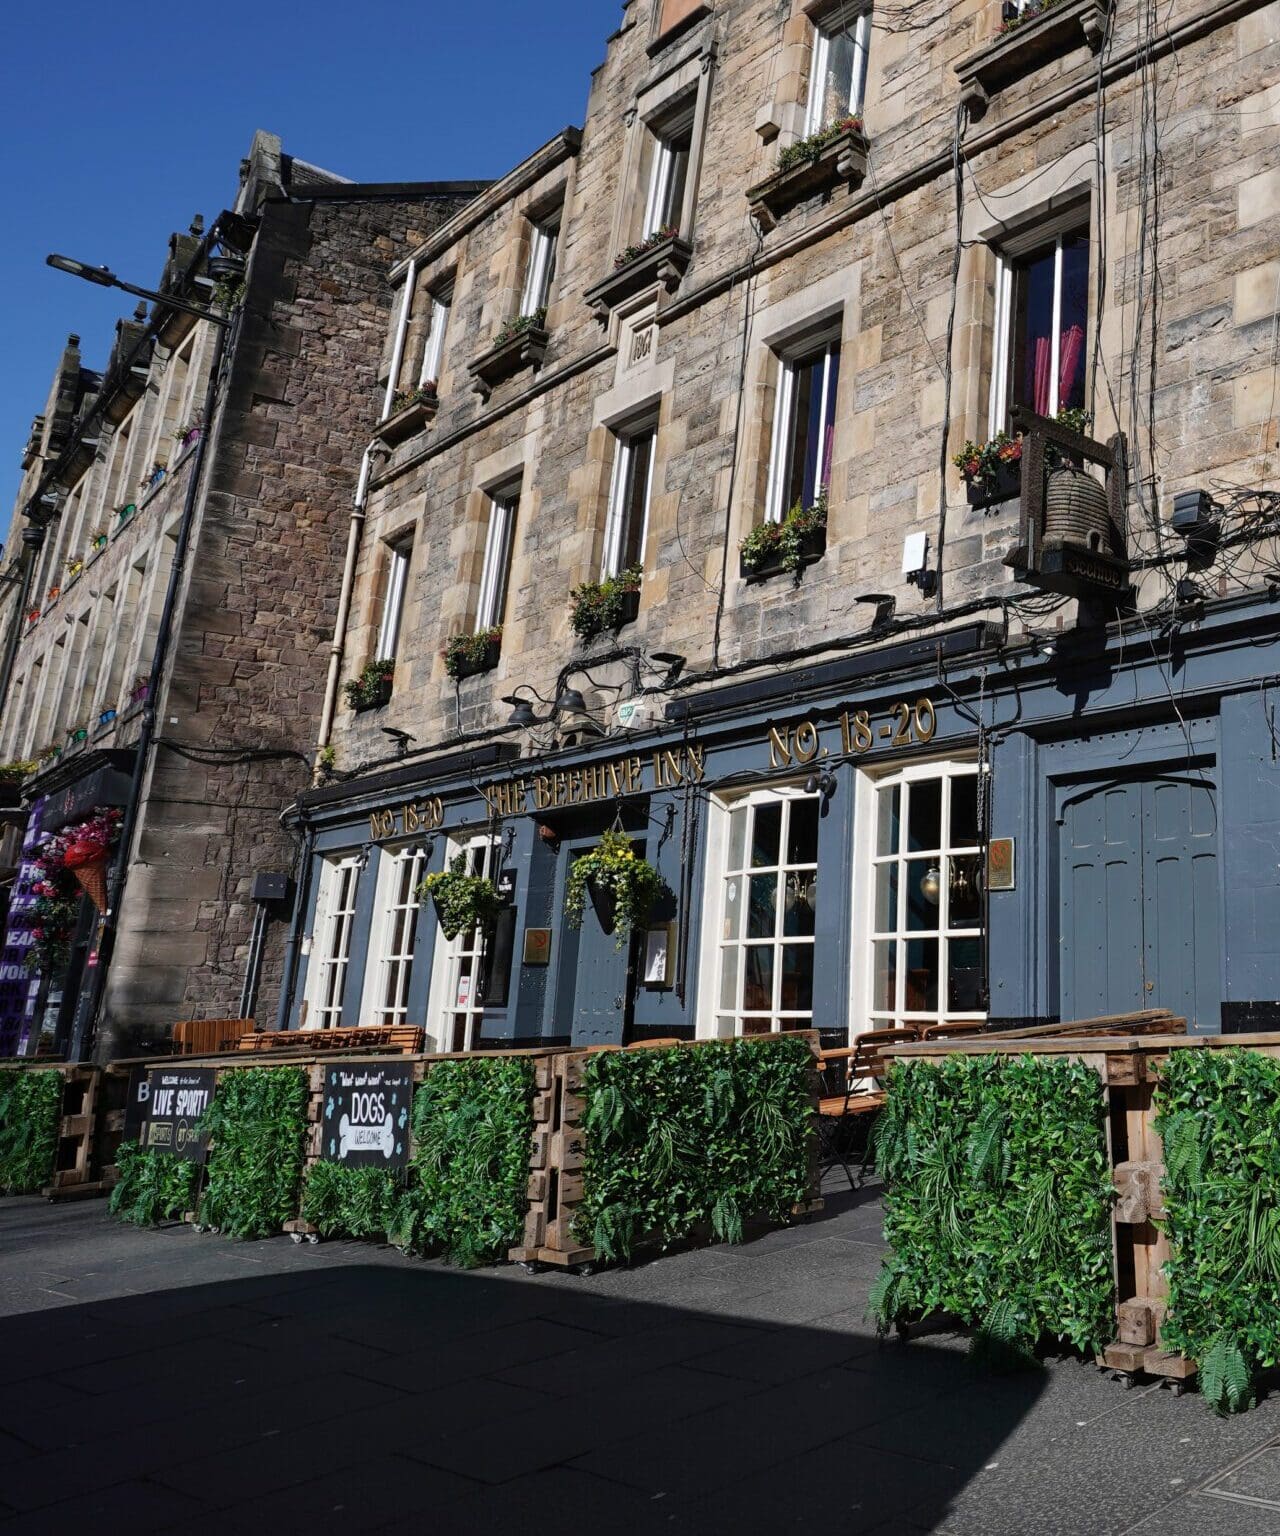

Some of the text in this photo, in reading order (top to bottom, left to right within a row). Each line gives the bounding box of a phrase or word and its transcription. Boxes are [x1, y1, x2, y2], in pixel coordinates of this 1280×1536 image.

[839, 697, 937, 754] 18-20
[484, 742, 705, 818] THE BEEHIVE INN
[401, 796, 444, 833] 18-20
[152, 1089, 175, 1116] LIVE
[351, 1092, 385, 1124] DOGS
[354, 1130, 381, 1146] WELCOME
